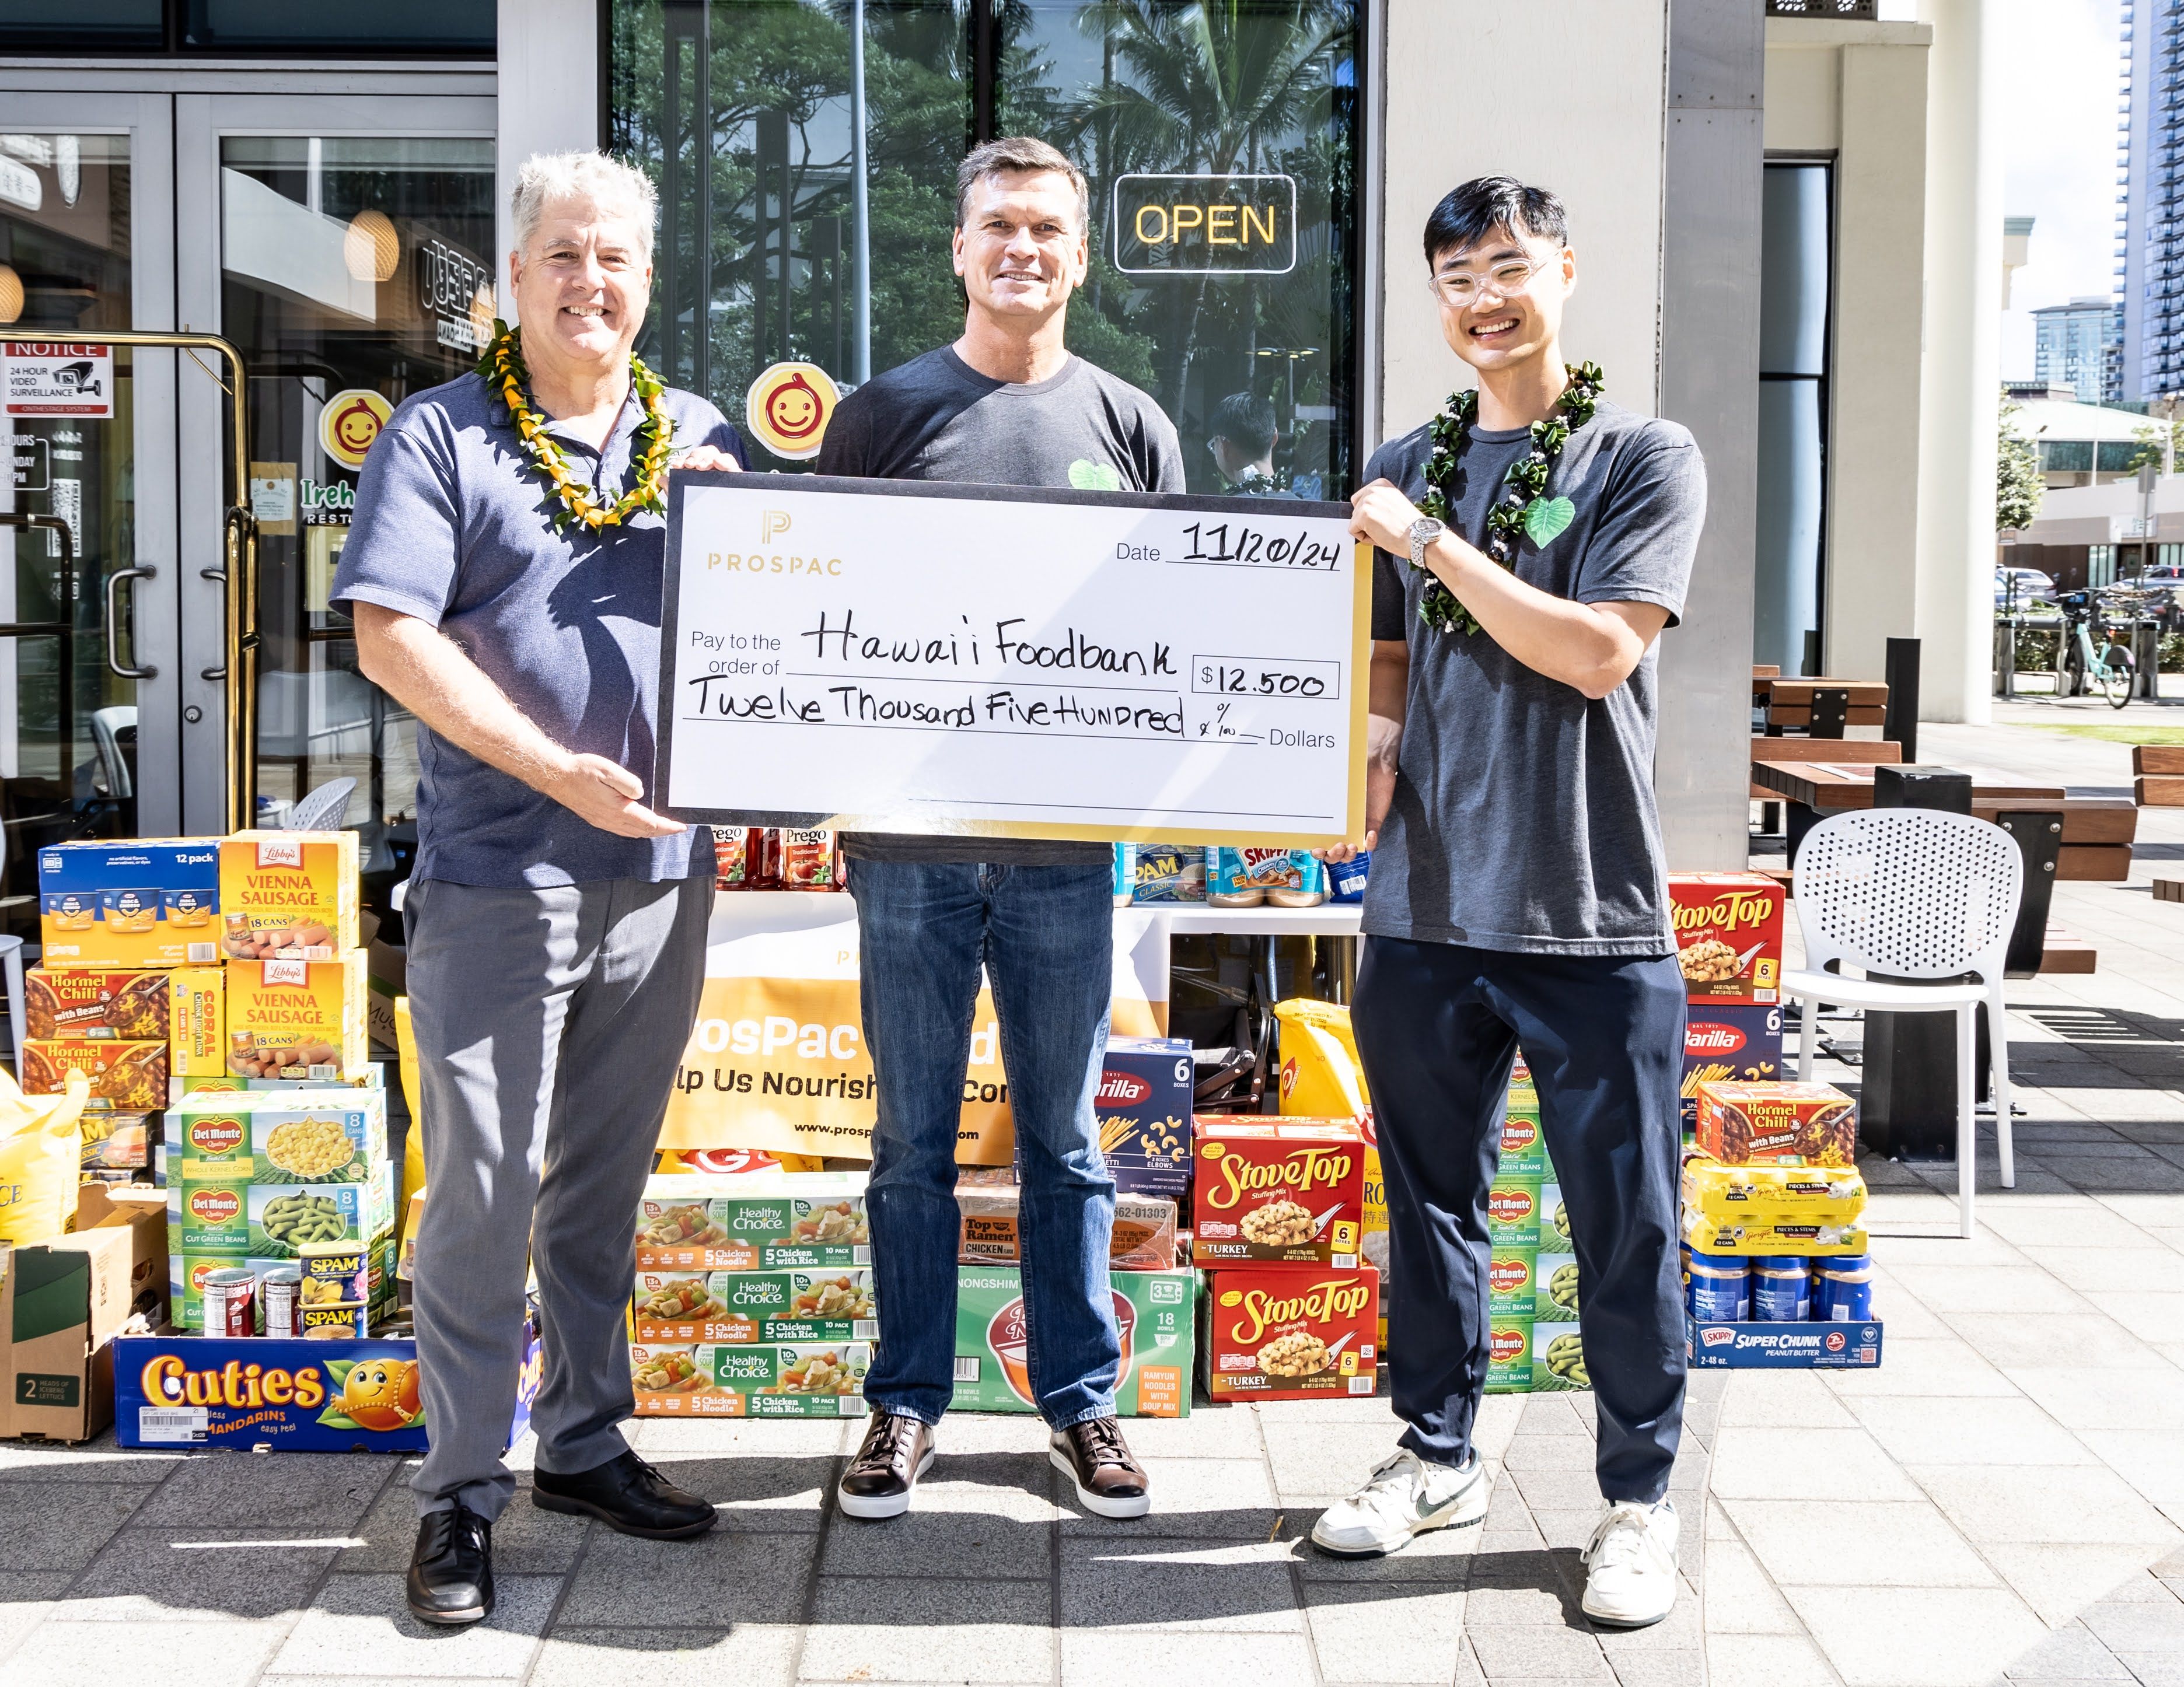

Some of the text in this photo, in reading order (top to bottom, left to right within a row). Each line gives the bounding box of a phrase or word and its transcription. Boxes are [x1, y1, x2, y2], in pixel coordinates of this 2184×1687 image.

[1136, 205, 1274, 244] OPEN
[16, 344, 97, 356] NOTICE
[1117, 543, 1160, 562] Date
[1183, 522, 1340, 571] 11/20/24
[708, 552, 842, 576] PROSPAC
[691, 631, 781, 650] Pay to the
[996, 618, 1177, 677] Foodbank
[709, 660, 780, 676] order of
[689, 674, 826, 723] Twelve
[829, 687, 974, 728] Thousand
[1270, 729, 1335, 748] Dollars
[787, 829, 826, 845] Prego
[176, 853, 214, 864] 12 pack
[263, 846, 295, 860] Libby's
[1134, 856, 1179, 886] PAM
[1257, 862, 1274, 873] CREAMY
[246, 876, 313, 889] VIENNA
[1138, 881, 1172, 897] CLASSIC
[241, 892, 319, 905] SAUSAGE
[251, 919, 261, 928] 18
[51, 975, 106, 986] Hormel
[60, 988, 96, 999] Chili
[54, 1004, 104, 1021] with Beans
[204, 990, 215, 1057] CORAL
[89, 1028, 95, 1037] 6
[47, 1045, 102, 1057] Hormel
[55, 1058, 92, 1069] Chili
[1174, 1059, 1190, 1082] 6
[714, 1069, 753, 1093] Us
[762, 1072, 876, 1100] Nourish
[1097, 1080, 1137, 1098] rilla
[1747, 1104, 1797, 1115] Hormel
[351, 1114, 360, 1126] 8
[1755, 1115, 1788, 1128] Chili
[194, 1129, 240, 1139] Del Monte
[1506, 1128, 1533, 1138] Monte
[1749, 1133, 1794, 1149] with Beans
[1252, 1191, 1275, 1200] Stuffing
[193, 1199, 237, 1209] Del Monte
[966, 1219, 991, 1232] Top
[966, 1230, 1014, 1241] Ramen
[1339, 1227, 1348, 1239] 6
[1746, 1228, 1772, 1242] Giorgio
[966, 1244, 1003, 1254] CHICKEN
[1208, 1244, 1248, 1254] TURKEY
[310, 1258, 359, 1273] SPAM
[958, 1279, 1018, 1289] NONGSHIM
[1153, 1286, 1162, 1298] 3
[1157, 1312, 1175, 1325] 18
[1707, 1329, 1732, 1342] SKIPPY
[1735, 1334, 1822, 1349] SUPER CHUNK
[699, 1358, 713, 1366] SOUP
[726, 1355, 768, 1368] Healthy
[1701, 1356, 1717, 1364] 2-48
[719, 1366, 769, 1378] Choice
[1144, 1372, 1175, 1380] RAMYUN
[141, 1353, 326, 1409] Cuties
[1144, 1382, 1176, 1390] NOODLES
[25, 1380, 36, 1398] 2
[692, 1396, 701, 1409] 5
[702, 1396, 738, 1405] Chicken
[752, 1396, 799, 1408] 5 Chicken
[1143, 1402, 1176, 1411] SOUP MIX
[208, 1411, 225, 1419] less
[703, 1405, 734, 1413] Noodle
[208, 1411, 285, 1434] MANDARINS
[261, 1425, 278, 1434] easy
